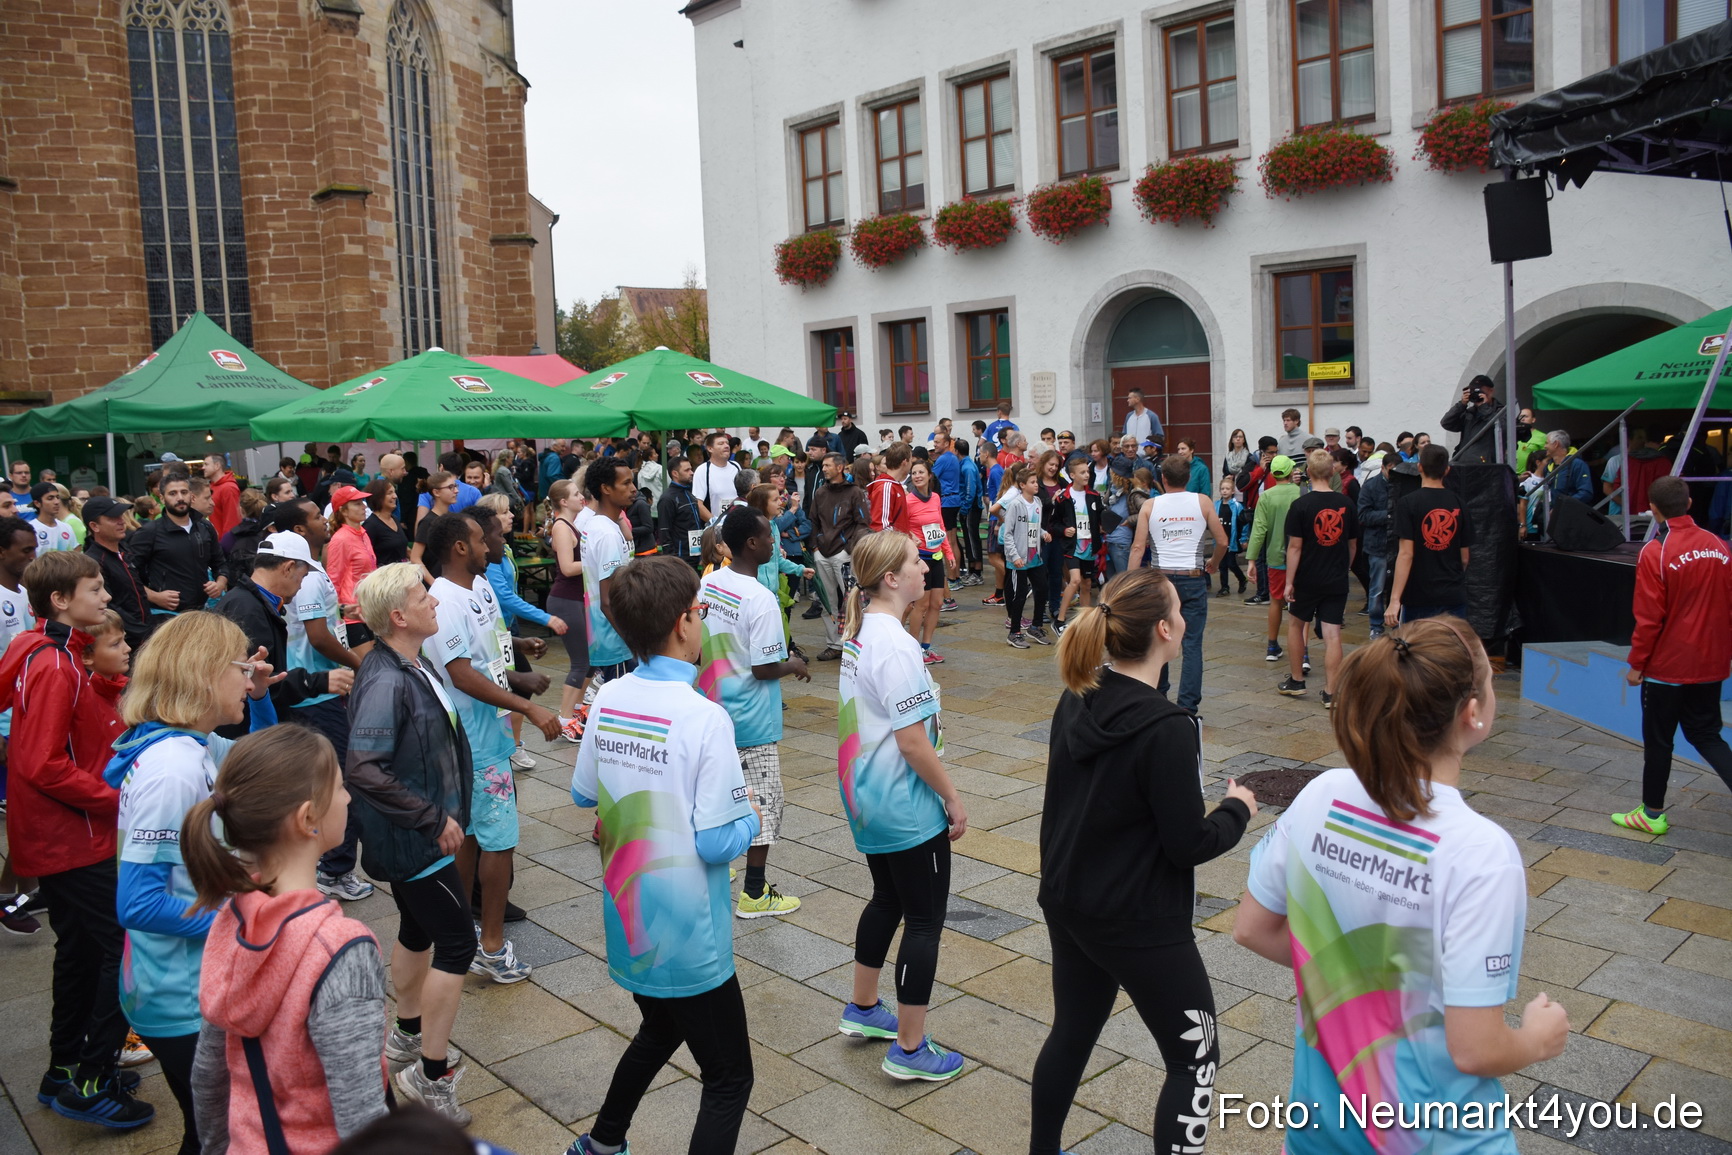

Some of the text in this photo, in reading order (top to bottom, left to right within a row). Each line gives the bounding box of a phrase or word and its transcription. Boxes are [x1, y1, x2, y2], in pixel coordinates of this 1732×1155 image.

[204, 373, 278, 384] Neumarkter
[196, 381, 299, 391] Lammsbräu
[691, 390, 754, 398] Neumarkter
[448, 396, 528, 405] Neumarkter
[686, 397, 775, 406] Lammsbräu
[440, 403, 552, 413] Lammsbräu
[1162, 528, 1192, 540] Dynamics
[1669, 548, 1729, 570] 1. FC Deining
[299, 603, 322, 612] BOCK
[1547, 658, 1560, 696] 2
[896, 690, 932, 712] BOCK
[356, 728, 394, 736] BOCK
[595, 734, 668, 765] NeuerMarkt
[621, 760, 635, 770] leben
[638, 765, 663, 776] genießen
[133, 829, 180, 841] BOCK
[1311, 832, 1433, 895] NeuerMarkt
[1315, 863, 1420, 911] einkaufen leben genießen
[1486, 953, 1511, 972] BO
[1171, 1061, 1216, 1155] idas
